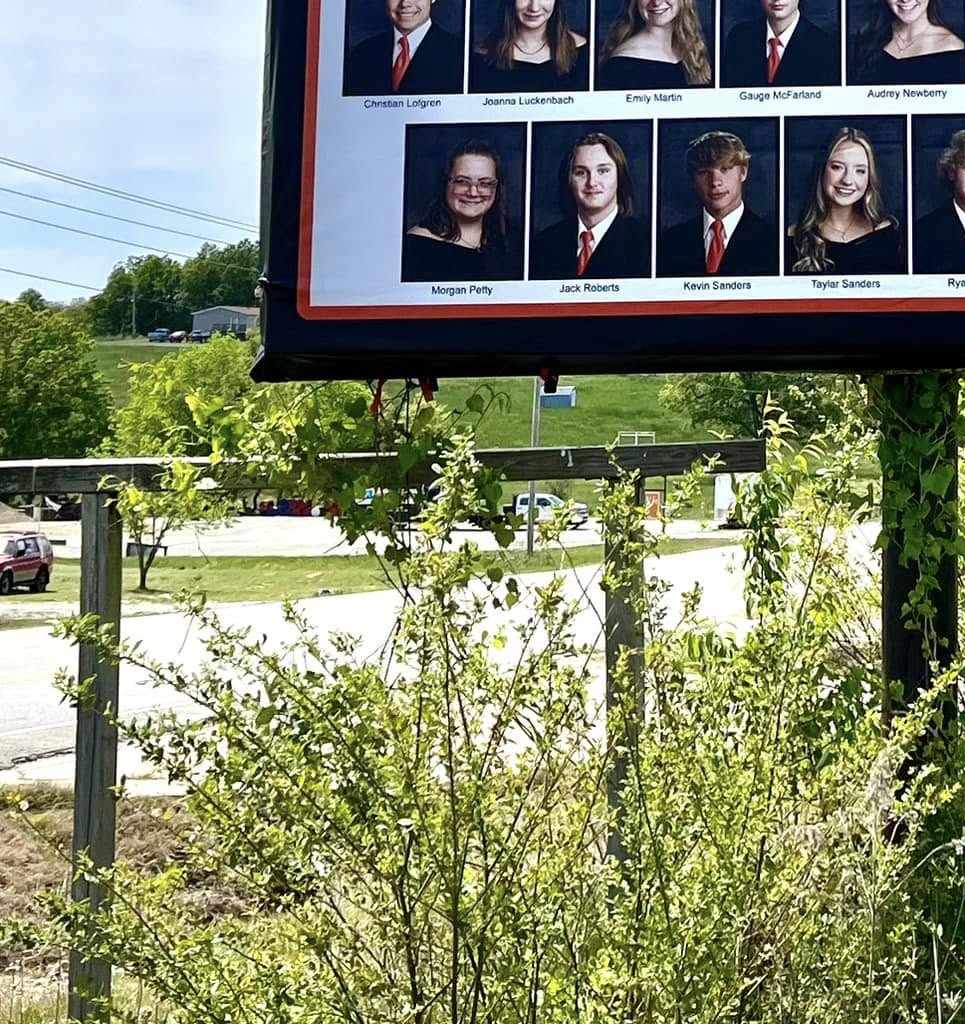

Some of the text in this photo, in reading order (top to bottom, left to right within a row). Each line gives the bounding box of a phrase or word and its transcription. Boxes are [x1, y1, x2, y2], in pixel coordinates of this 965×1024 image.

[625, 93, 683, 105] Emily Martin
[738, 89, 822, 103] Gauge McFarland
[866, 88, 948, 101] Audrey Newberry
[363, 97, 442, 110] Christian Lofgren
[481, 95, 575, 107] Joanna Luckenbach
[559, 282, 621, 294] Jack Roberts
[683, 280, 752, 292] Kevin Sanders
[841, 278, 881, 289] Sanders
[431, 284, 494, 297] Morgan Petty
